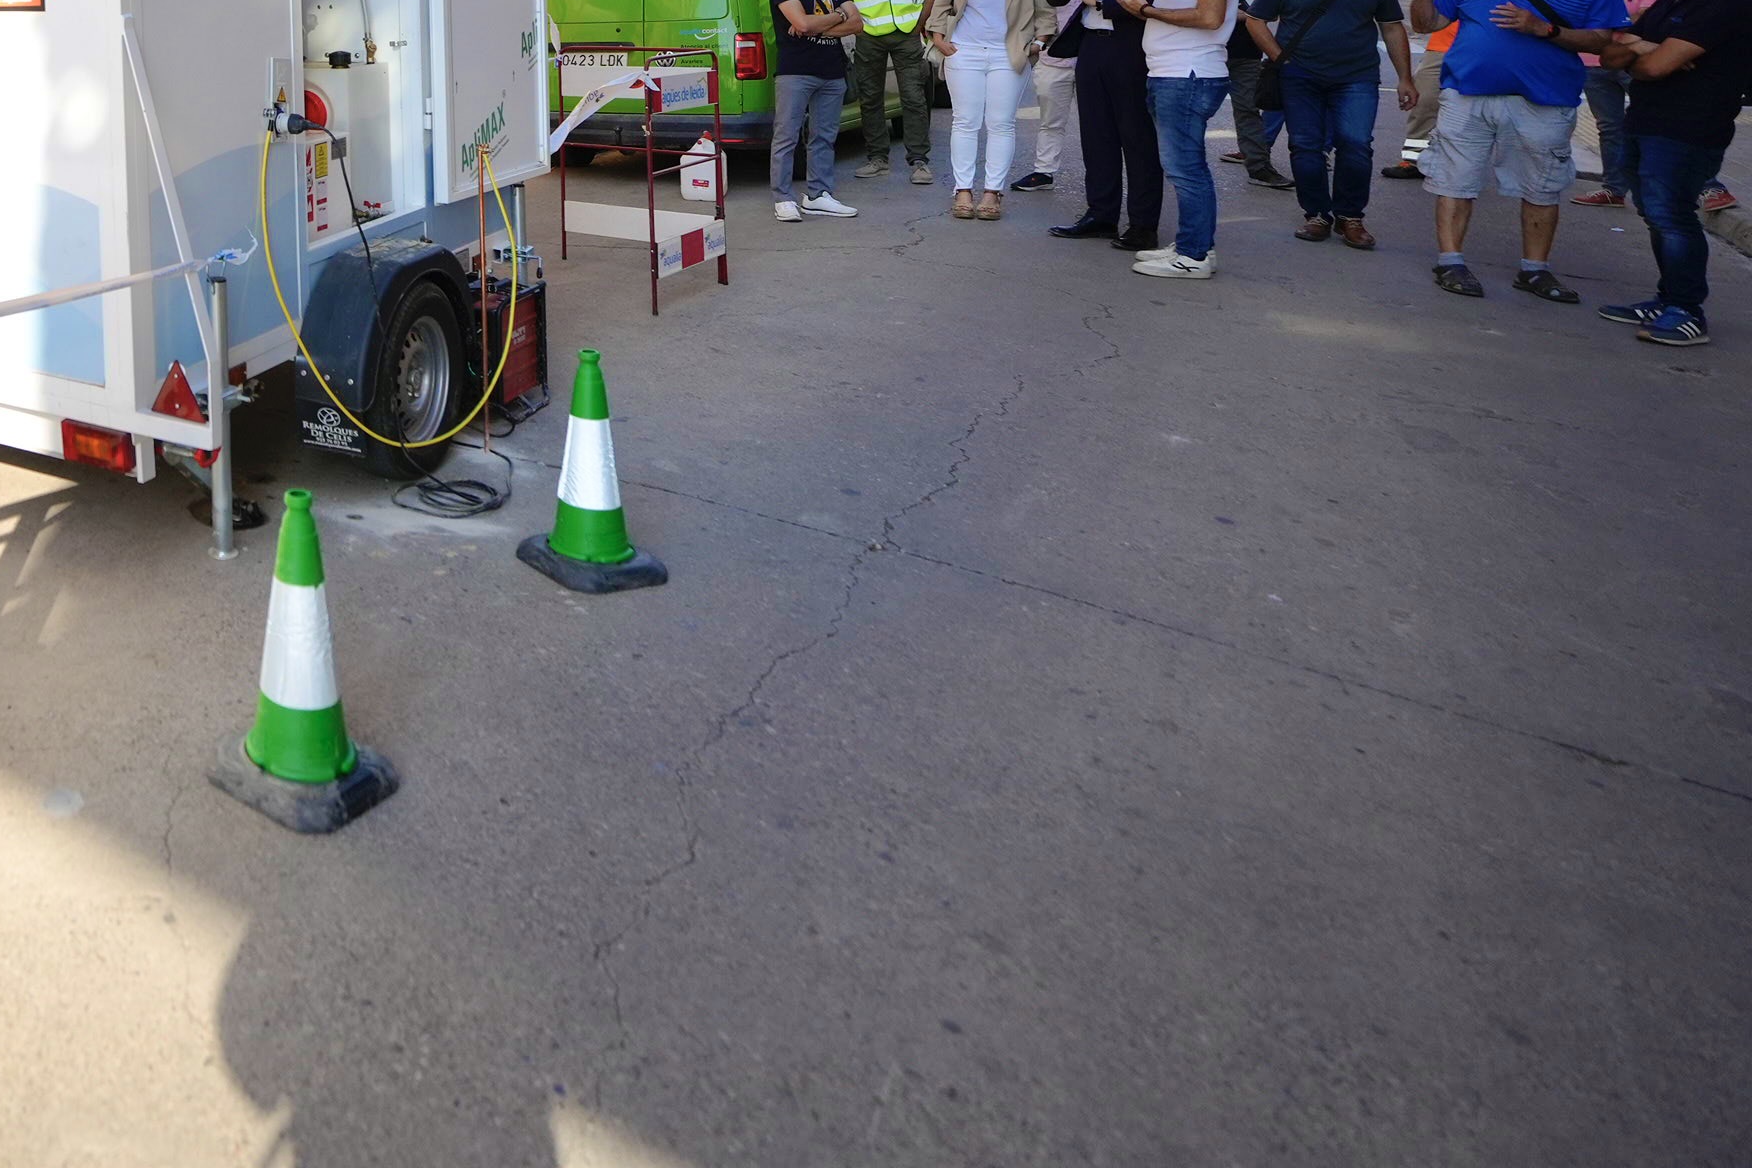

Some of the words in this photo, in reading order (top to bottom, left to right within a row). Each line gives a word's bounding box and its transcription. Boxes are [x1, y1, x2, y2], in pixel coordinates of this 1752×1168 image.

[562, 54, 595, 67] 0423
[600, 54, 624, 67] LDK
[461, 101, 506, 172] ApliMAX
[302, 420, 359, 437] REMOLQUES
[311, 429, 325, 438] DE
[325, 432, 353, 443] CELIS
